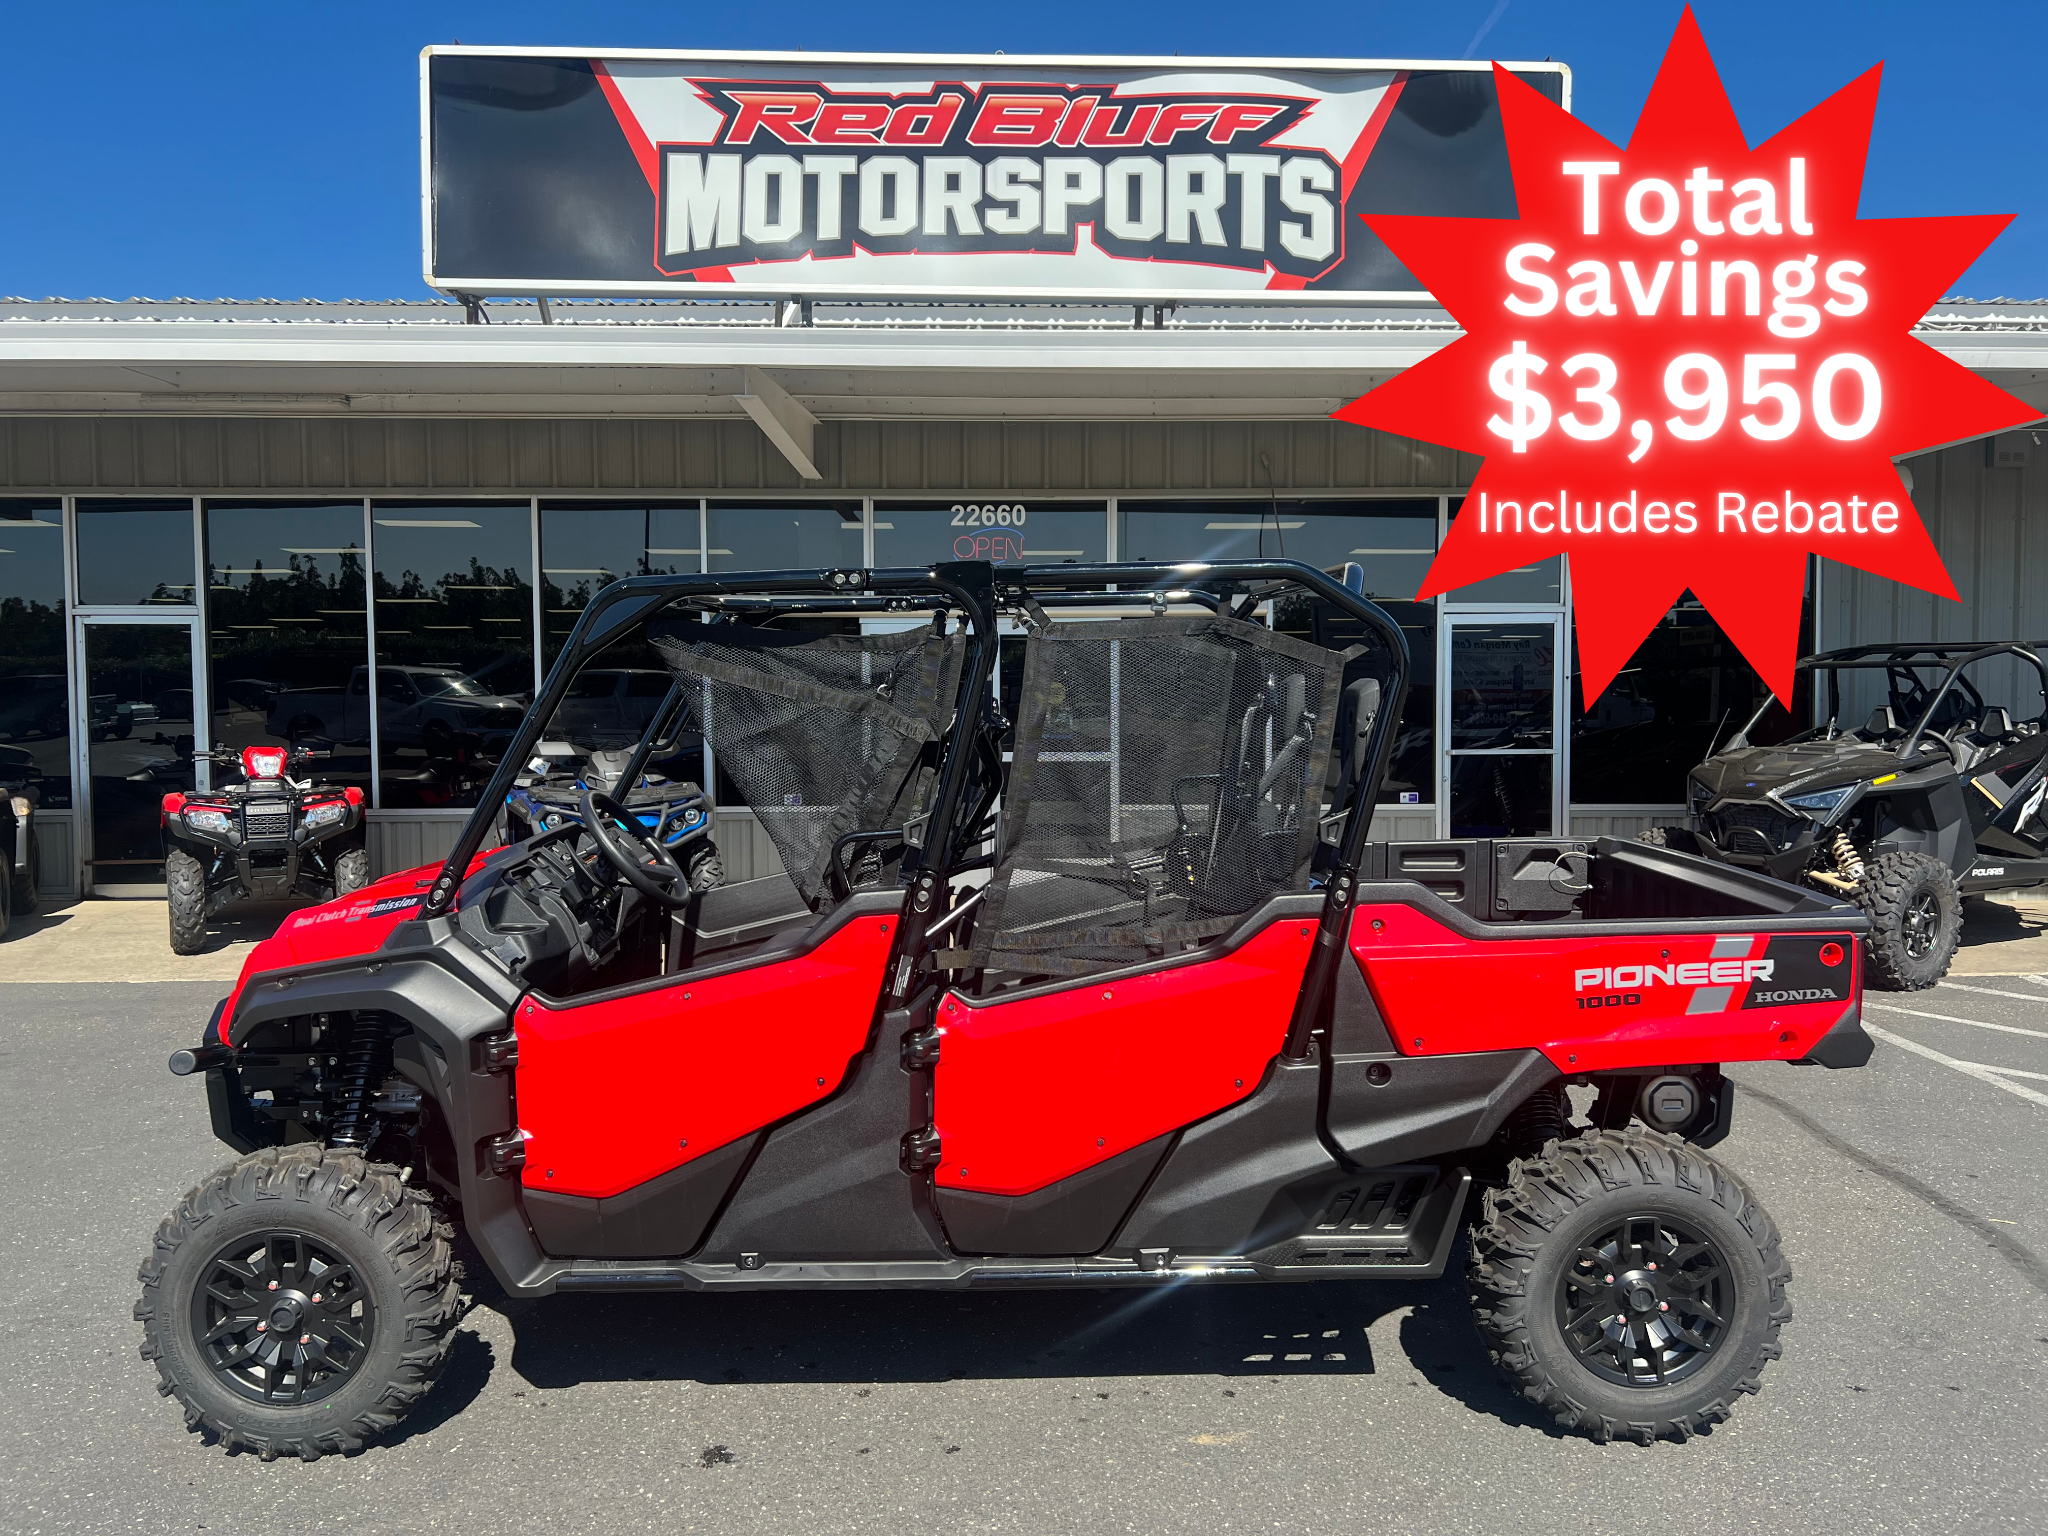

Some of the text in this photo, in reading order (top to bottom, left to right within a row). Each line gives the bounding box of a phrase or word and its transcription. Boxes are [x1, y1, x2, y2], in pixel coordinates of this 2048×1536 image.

[722, 90, 1290, 147] Red Bluff
[665, 152, 1335, 261] MOTORSPORTS
[950, 504, 1026, 526] 22660
[953, 535, 1024, 560] OPEN
[1971, 867, 2005, 877] POLARIS
[293, 897, 418, 929] Dual Clutch Transmission
[1575, 959, 1775, 991] PIONEER
[1576, 993, 1641, 1009] 1000
[1755, 988, 1838, 1003] HONDA
